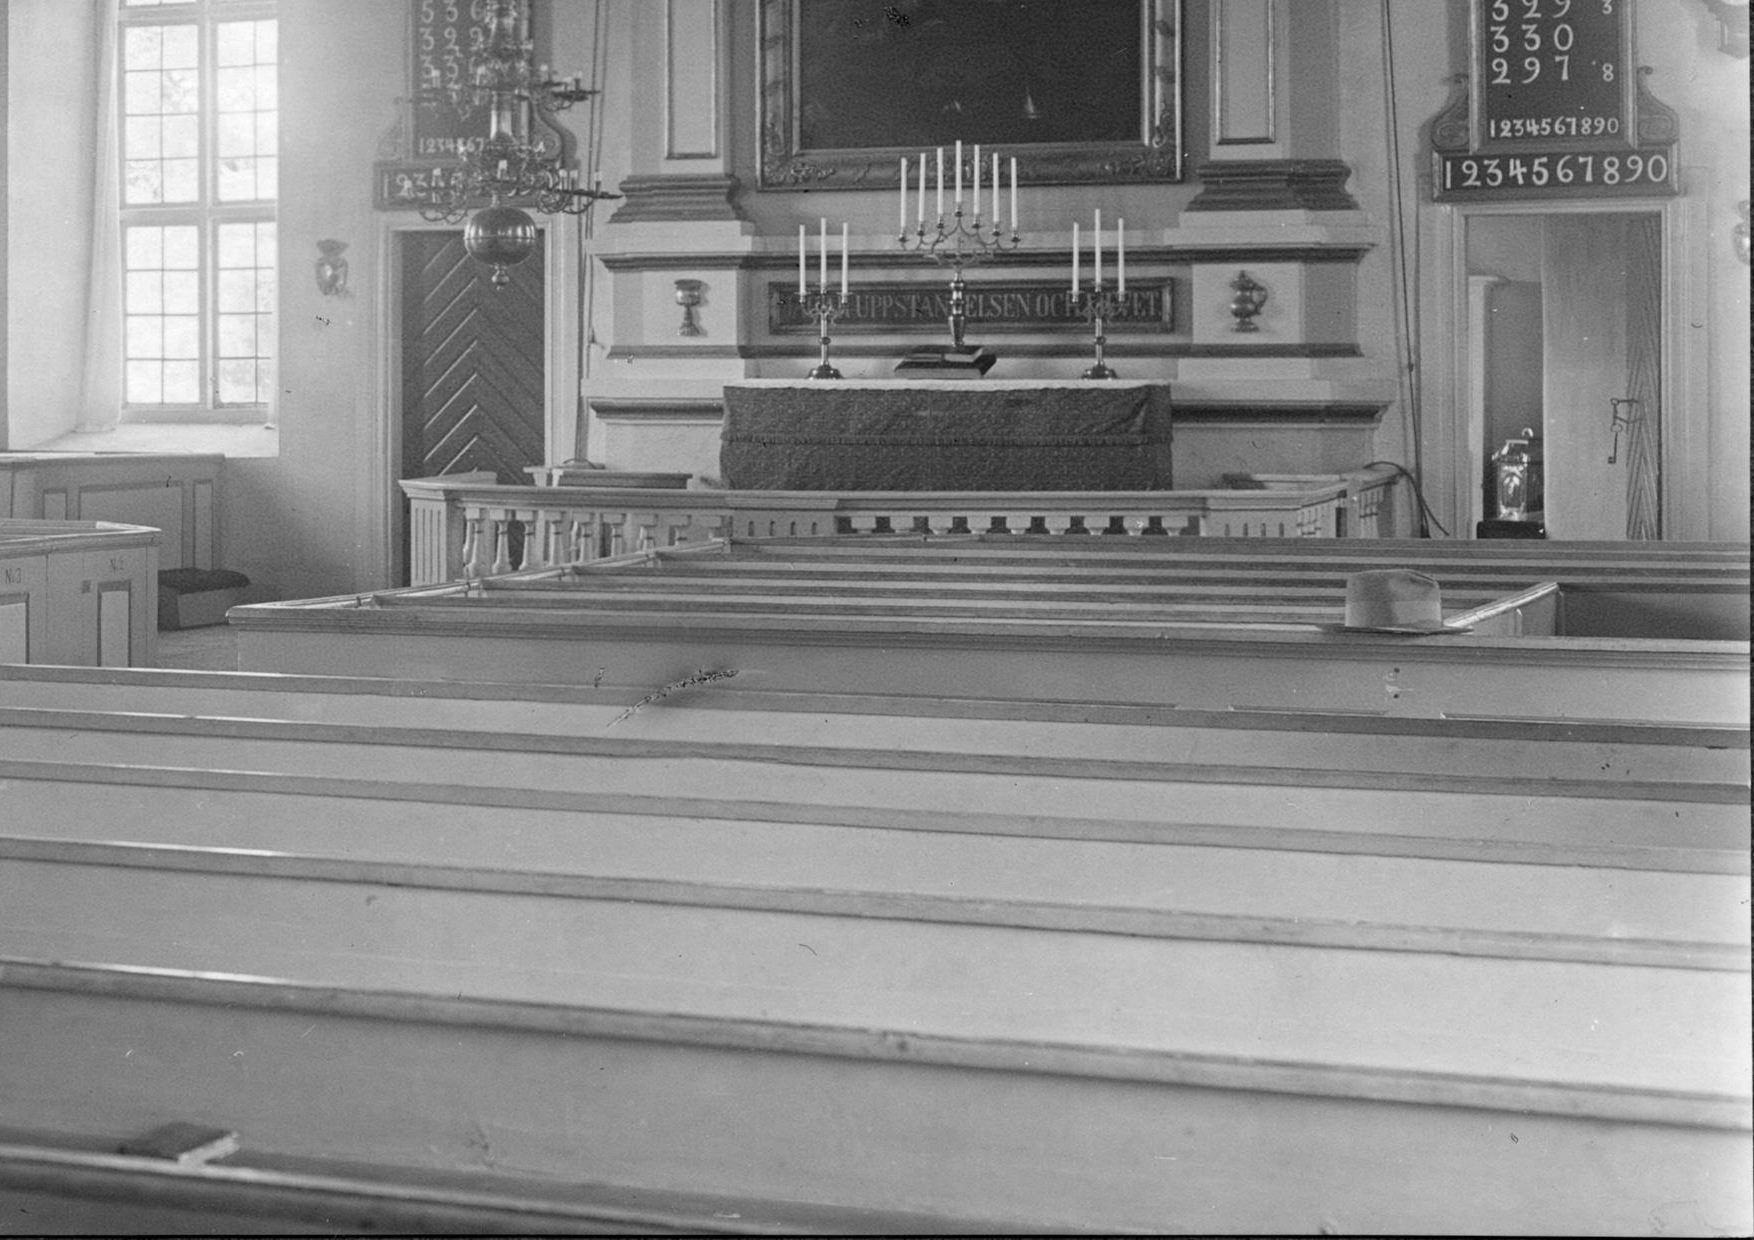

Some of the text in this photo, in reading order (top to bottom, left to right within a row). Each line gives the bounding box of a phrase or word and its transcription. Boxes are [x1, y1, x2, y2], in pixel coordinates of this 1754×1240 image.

[1601, 63, 1614, 82] 8
[1489, 117, 1619, 138] 1234567890
[1445, 154, 1668, 190] 1234567890
[854, 292, 1030, 319] UPPSTANELSEN
